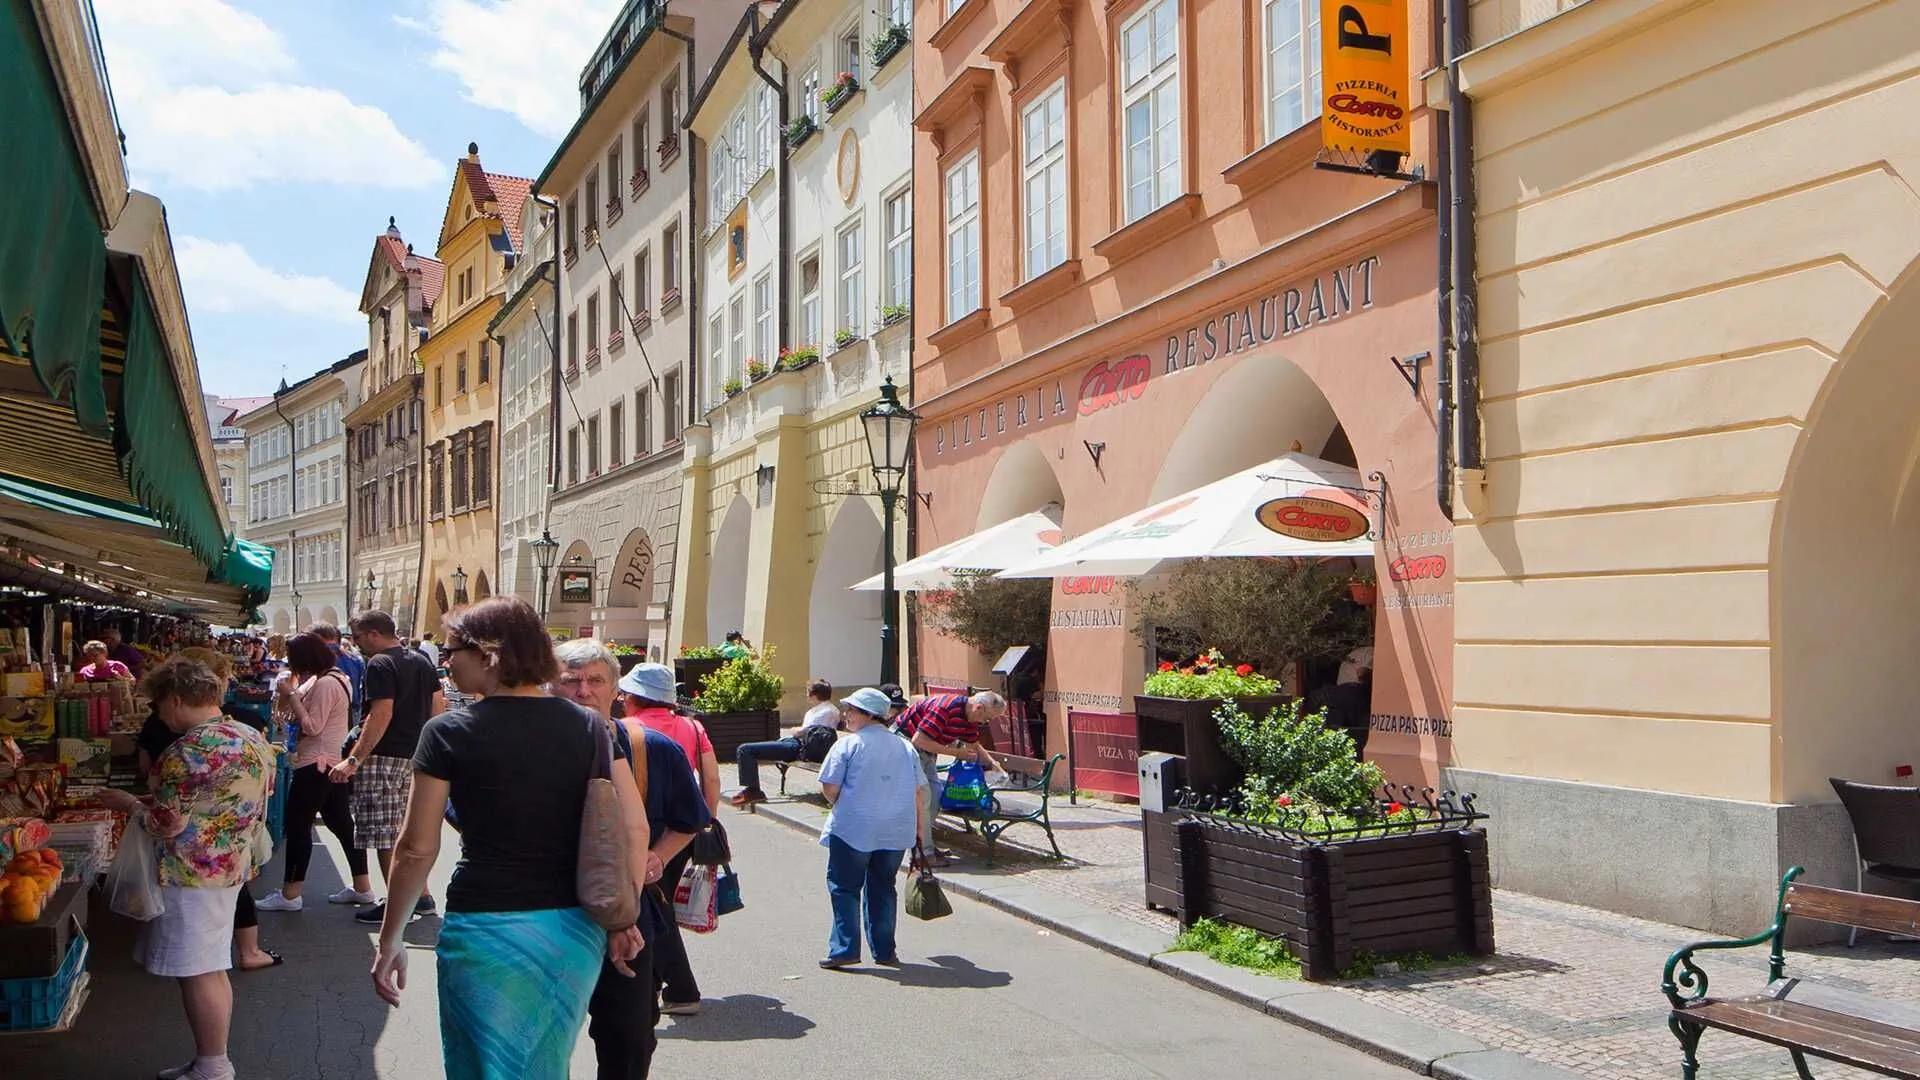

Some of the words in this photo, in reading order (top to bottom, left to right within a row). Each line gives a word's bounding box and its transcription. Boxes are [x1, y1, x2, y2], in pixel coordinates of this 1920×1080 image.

[1336, 80, 1397, 100] PIZZERIA
[1328, 114, 1403, 137] RISTORANTE
[935, 379, 1066, 457] PIZZERIA
[1164, 256, 1381, 376] RESTAURANT
[1051, 608, 1124, 629] RESTAURANT
[1371, 714, 1397, 732] PIZZA
[1399, 716, 1429, 735] PASTA
[1096, 745, 1124, 760] PIZZA
